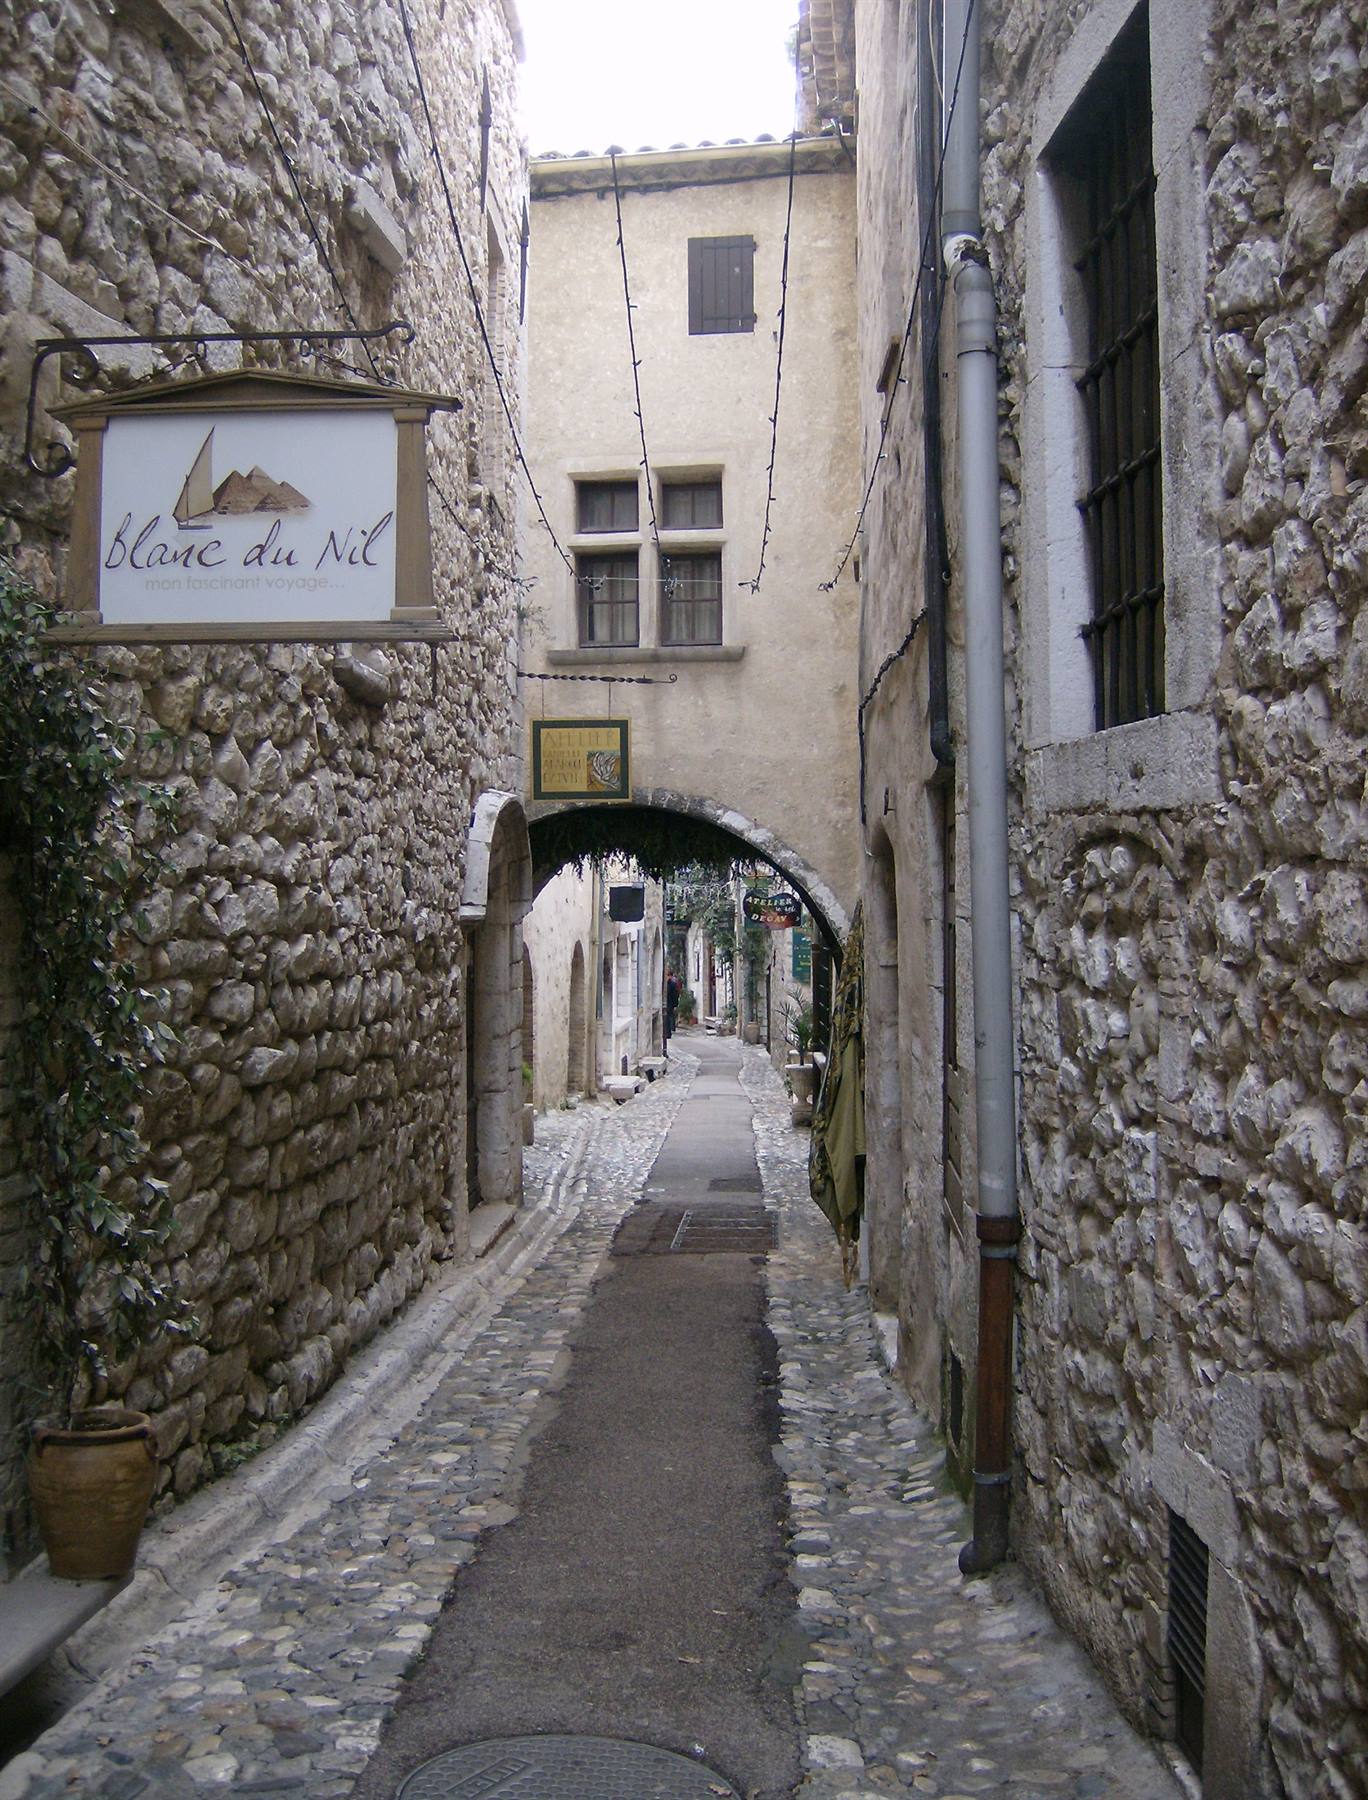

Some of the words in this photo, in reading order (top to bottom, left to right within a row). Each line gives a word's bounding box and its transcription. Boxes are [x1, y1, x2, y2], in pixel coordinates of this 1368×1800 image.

[105, 511, 227, 570] Blanc
[243, 518, 298, 569] du
[315, 510, 393, 571] Nil
[145, 575, 181, 592] mon
[186, 574, 260, 591] fascinant
[745, 896, 793, 907] ATELIER
